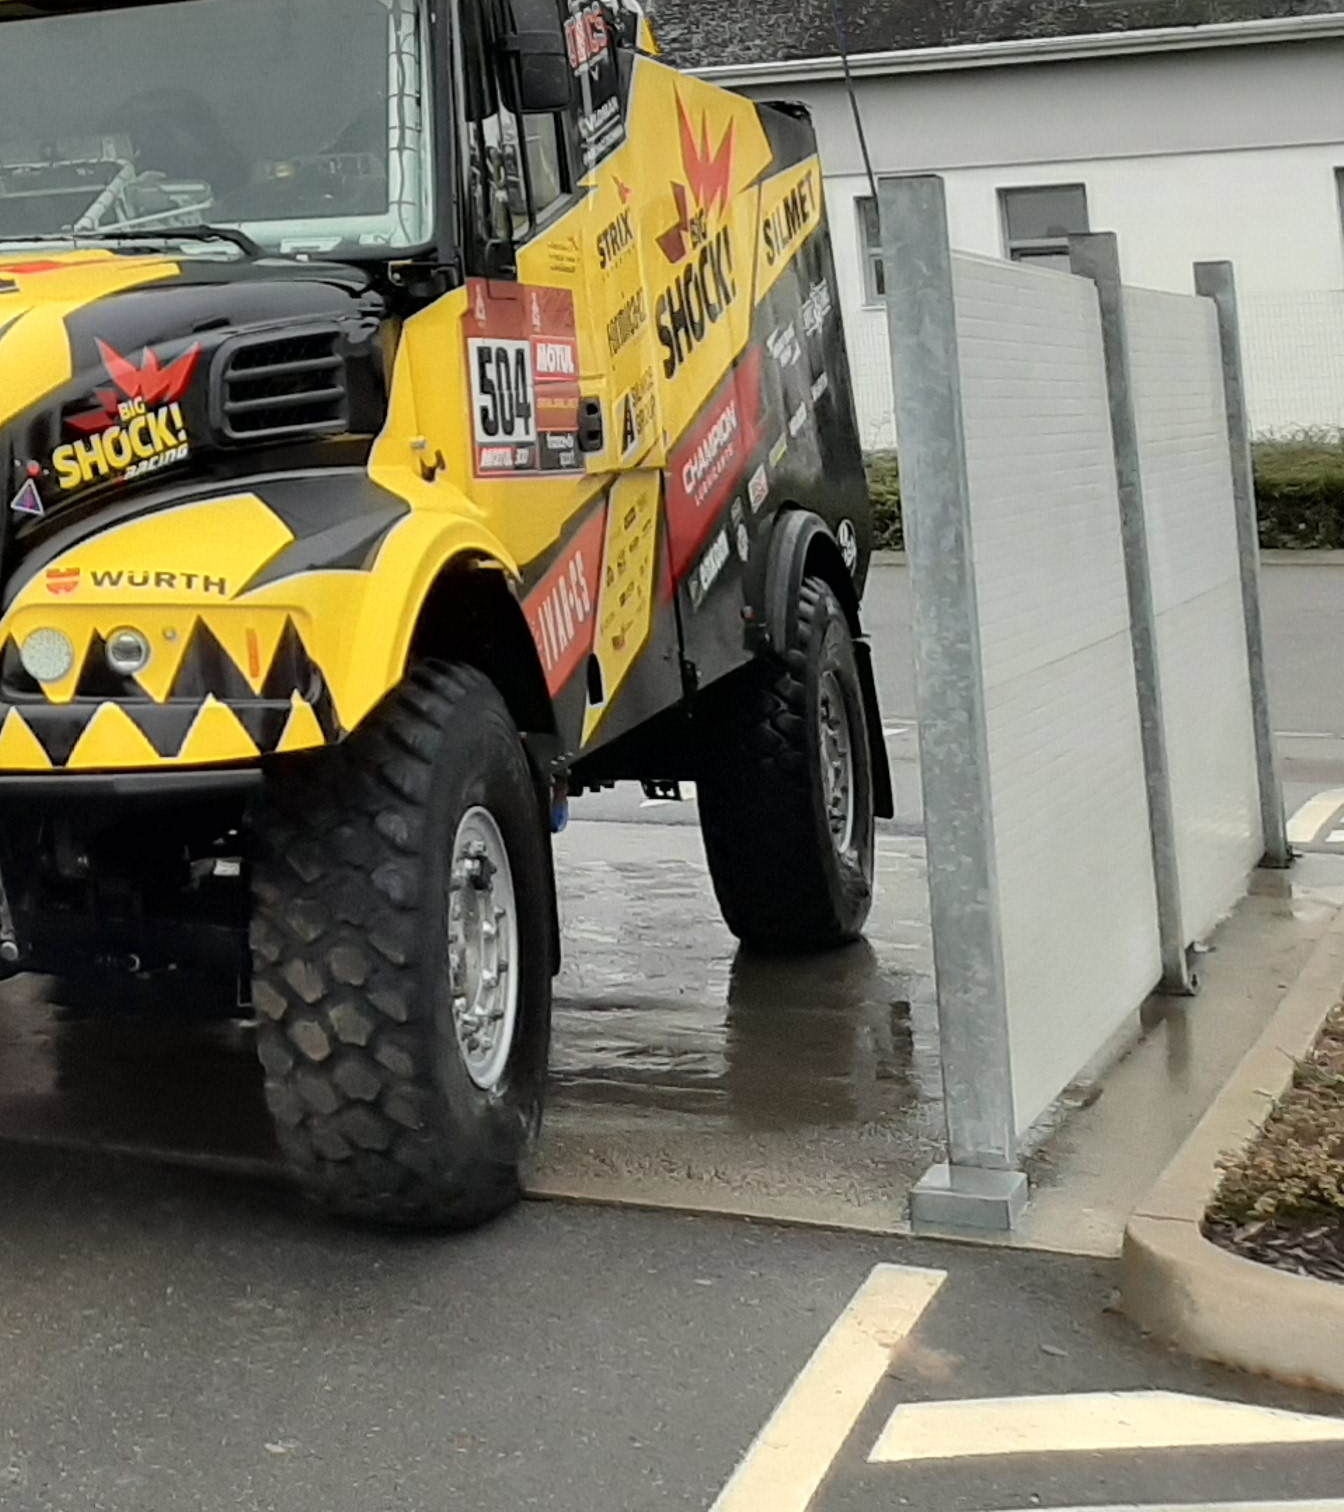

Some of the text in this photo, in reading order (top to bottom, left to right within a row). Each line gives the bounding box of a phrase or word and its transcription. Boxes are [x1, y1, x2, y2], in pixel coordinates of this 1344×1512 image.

[596, 207, 634, 270] STRIX
[762, 169, 816, 267] SILMET
[656, 223, 737, 380] SHOCK!
[476, 345, 532, 437] 504
[535, 343, 576, 374] MOTUL
[52, 401, 188, 490] SHOCK!
[117, 395, 146, 422] BIG
